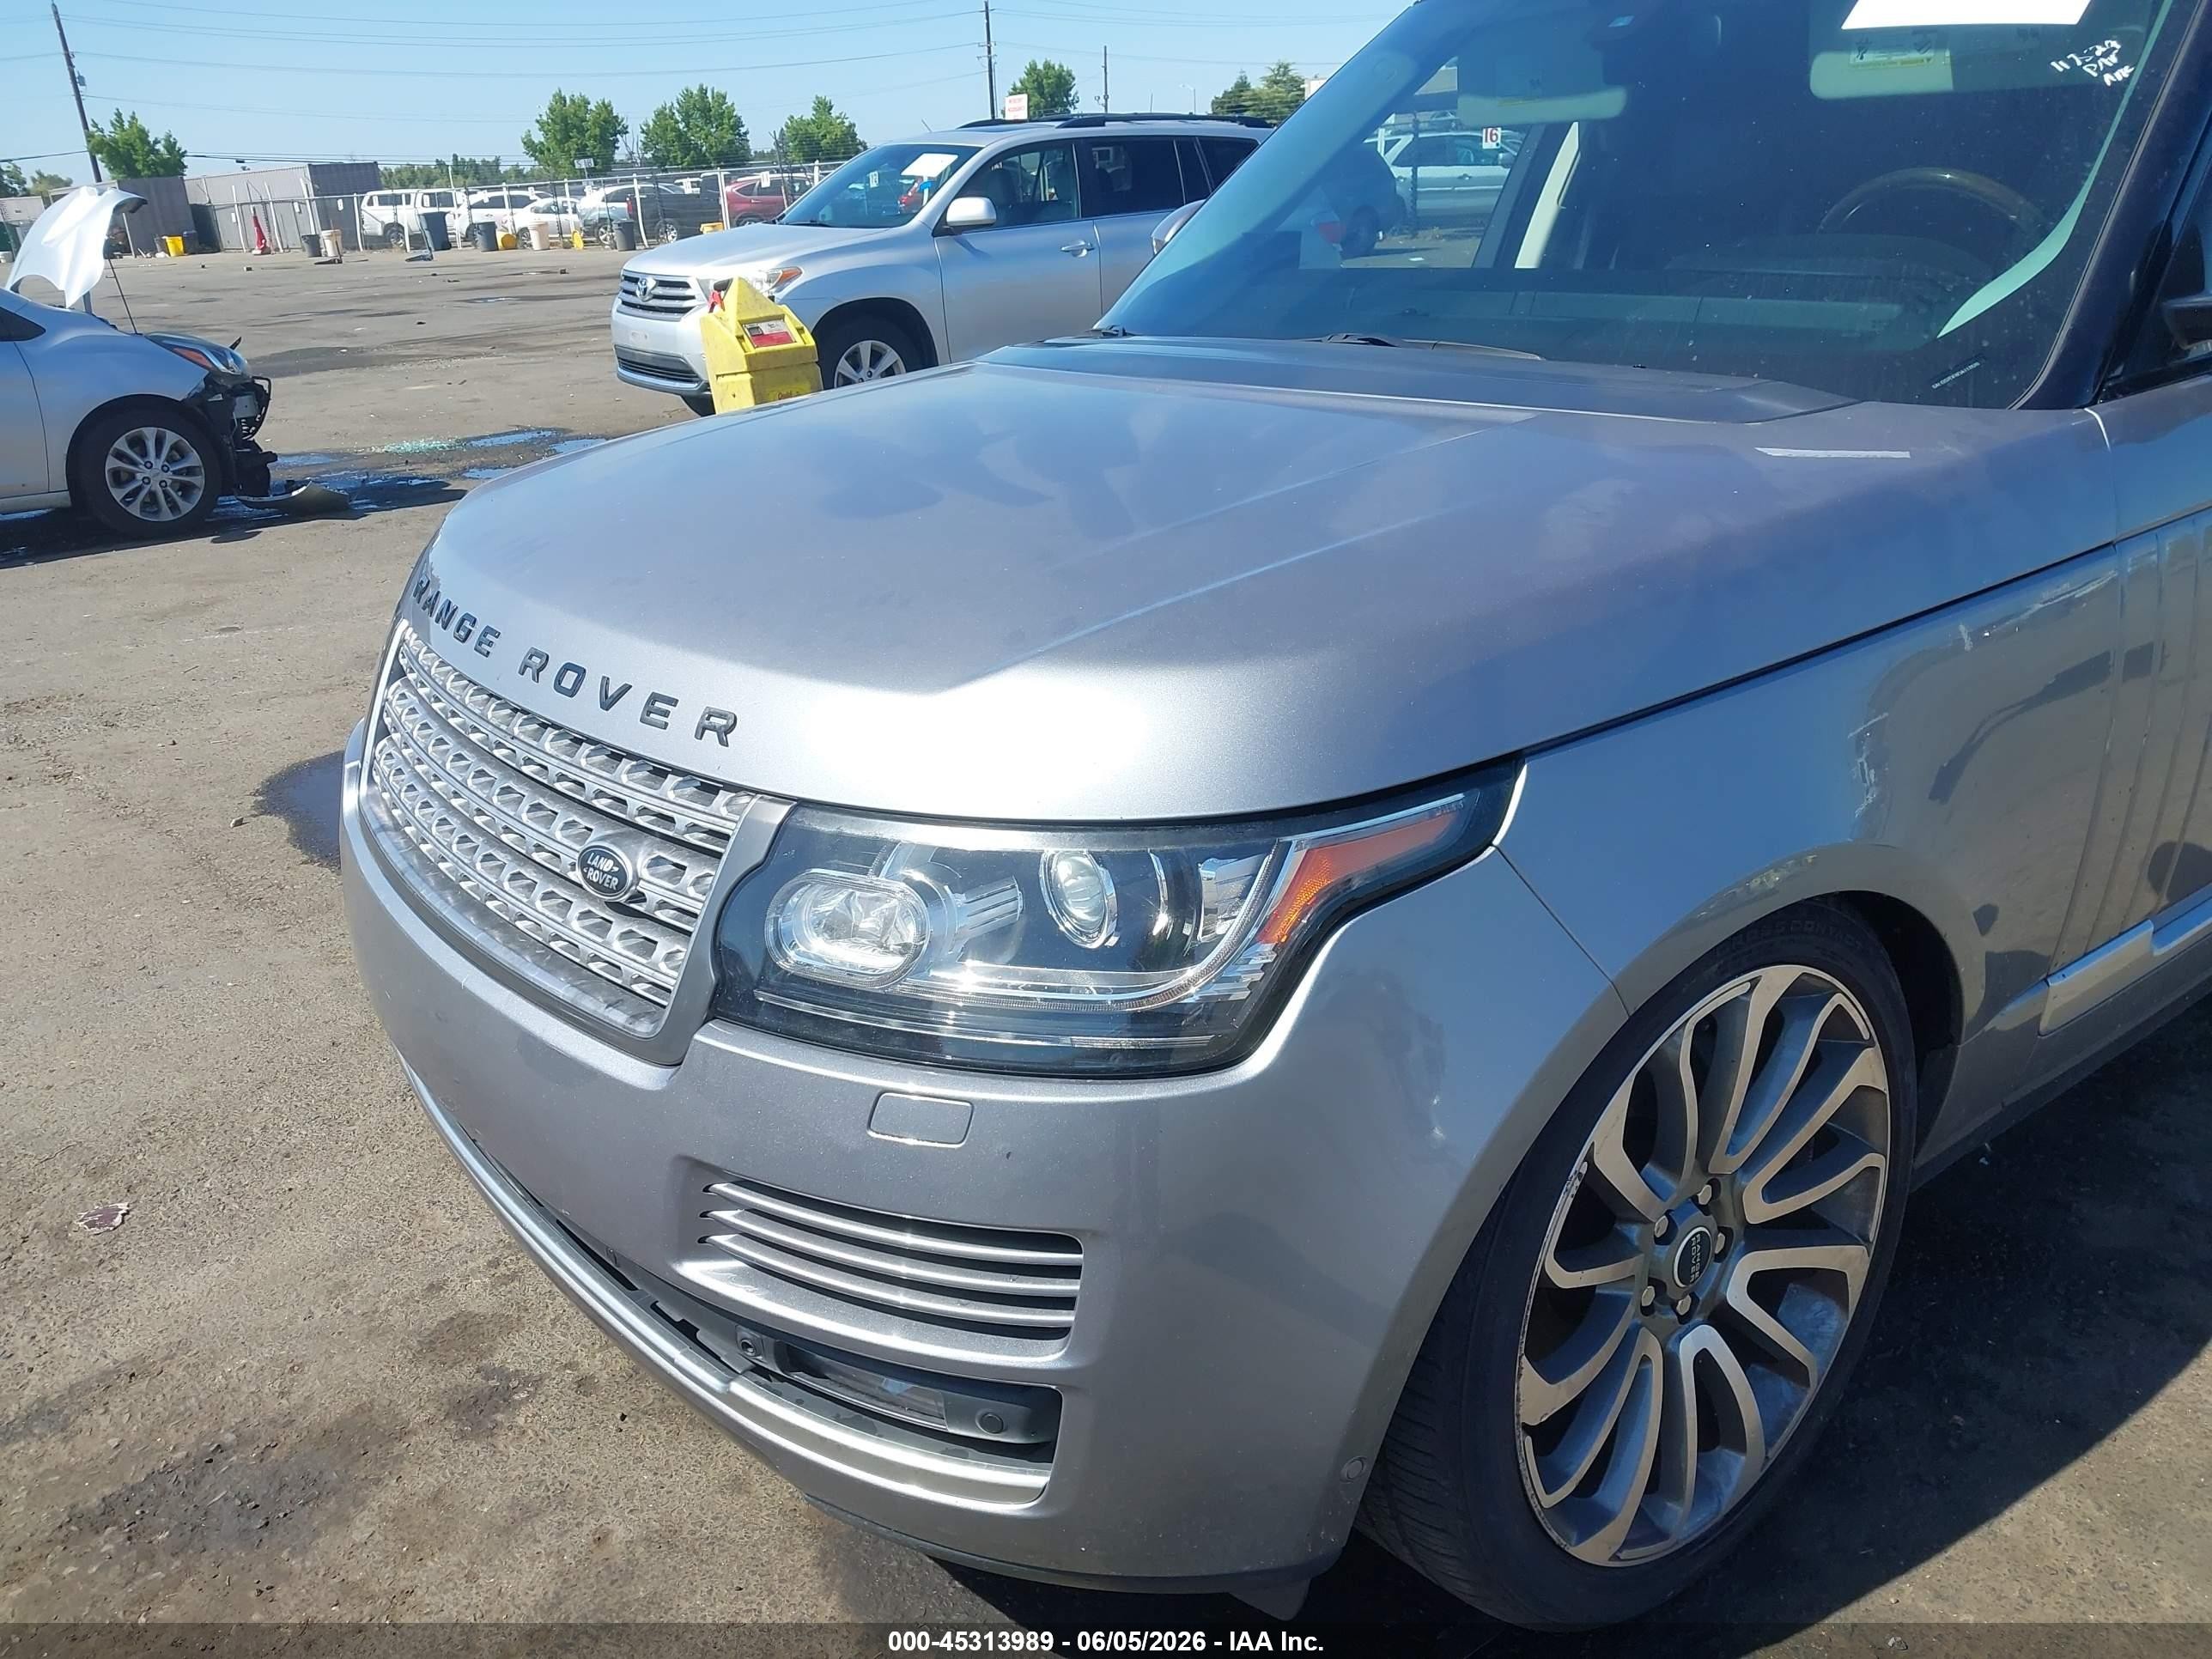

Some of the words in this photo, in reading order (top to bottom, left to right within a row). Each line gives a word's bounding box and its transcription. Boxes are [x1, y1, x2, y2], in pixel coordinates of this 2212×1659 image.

[1484, 128, 1498, 143] 16
[412, 573, 501, 658] RANGE
[518, 646, 738, 747] ROVER
[586, 852, 614, 872] LAND
[586, 867, 619, 890] ROVER
